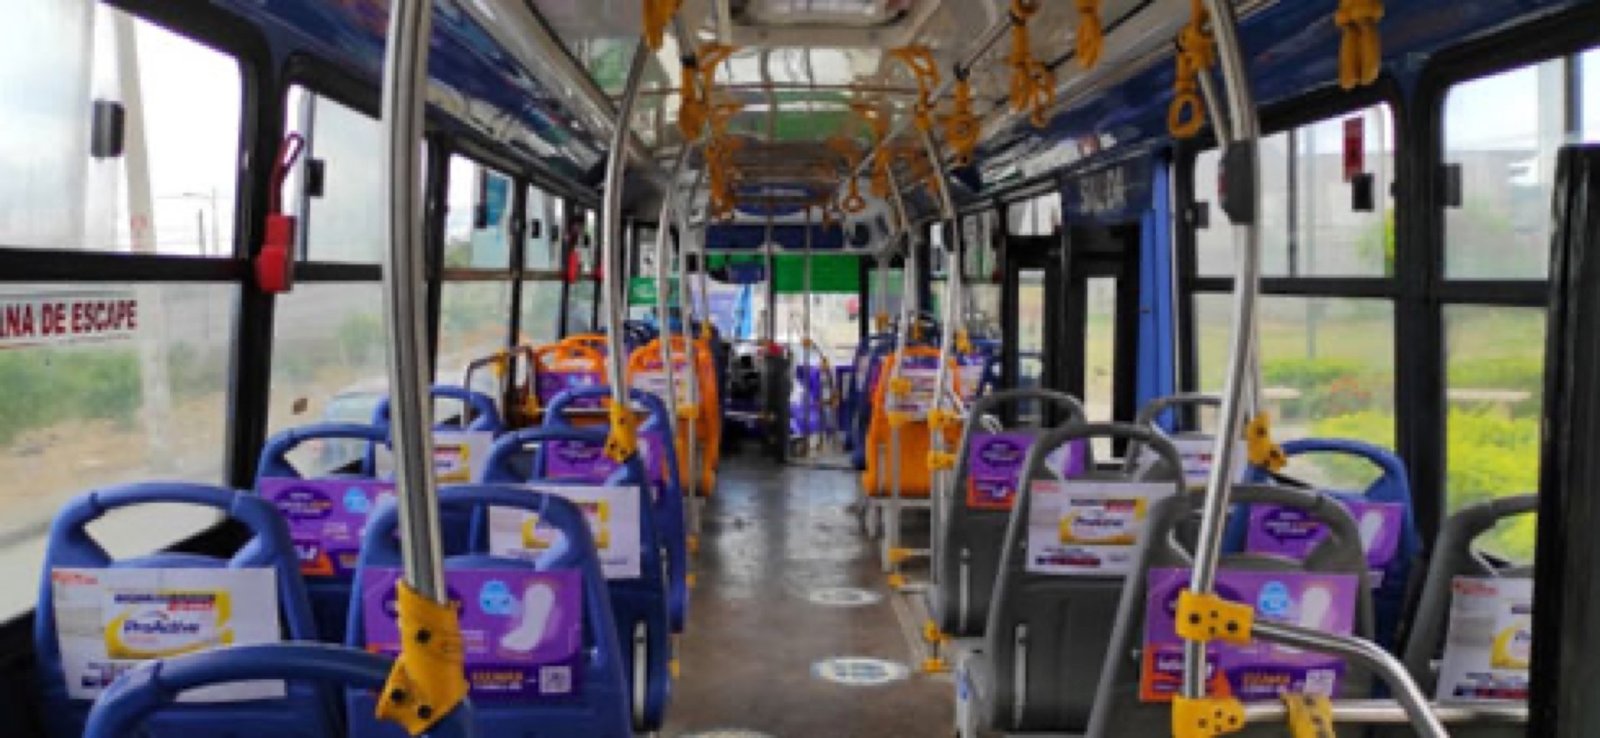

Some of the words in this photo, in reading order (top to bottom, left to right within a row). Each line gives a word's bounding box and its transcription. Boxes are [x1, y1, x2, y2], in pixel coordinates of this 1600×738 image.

[0, 303, 34, 338] NA
[42, 302, 66, 335] DE
[71, 299, 137, 334] ESCAPE
[123, 619, 200, 635] ProActive
